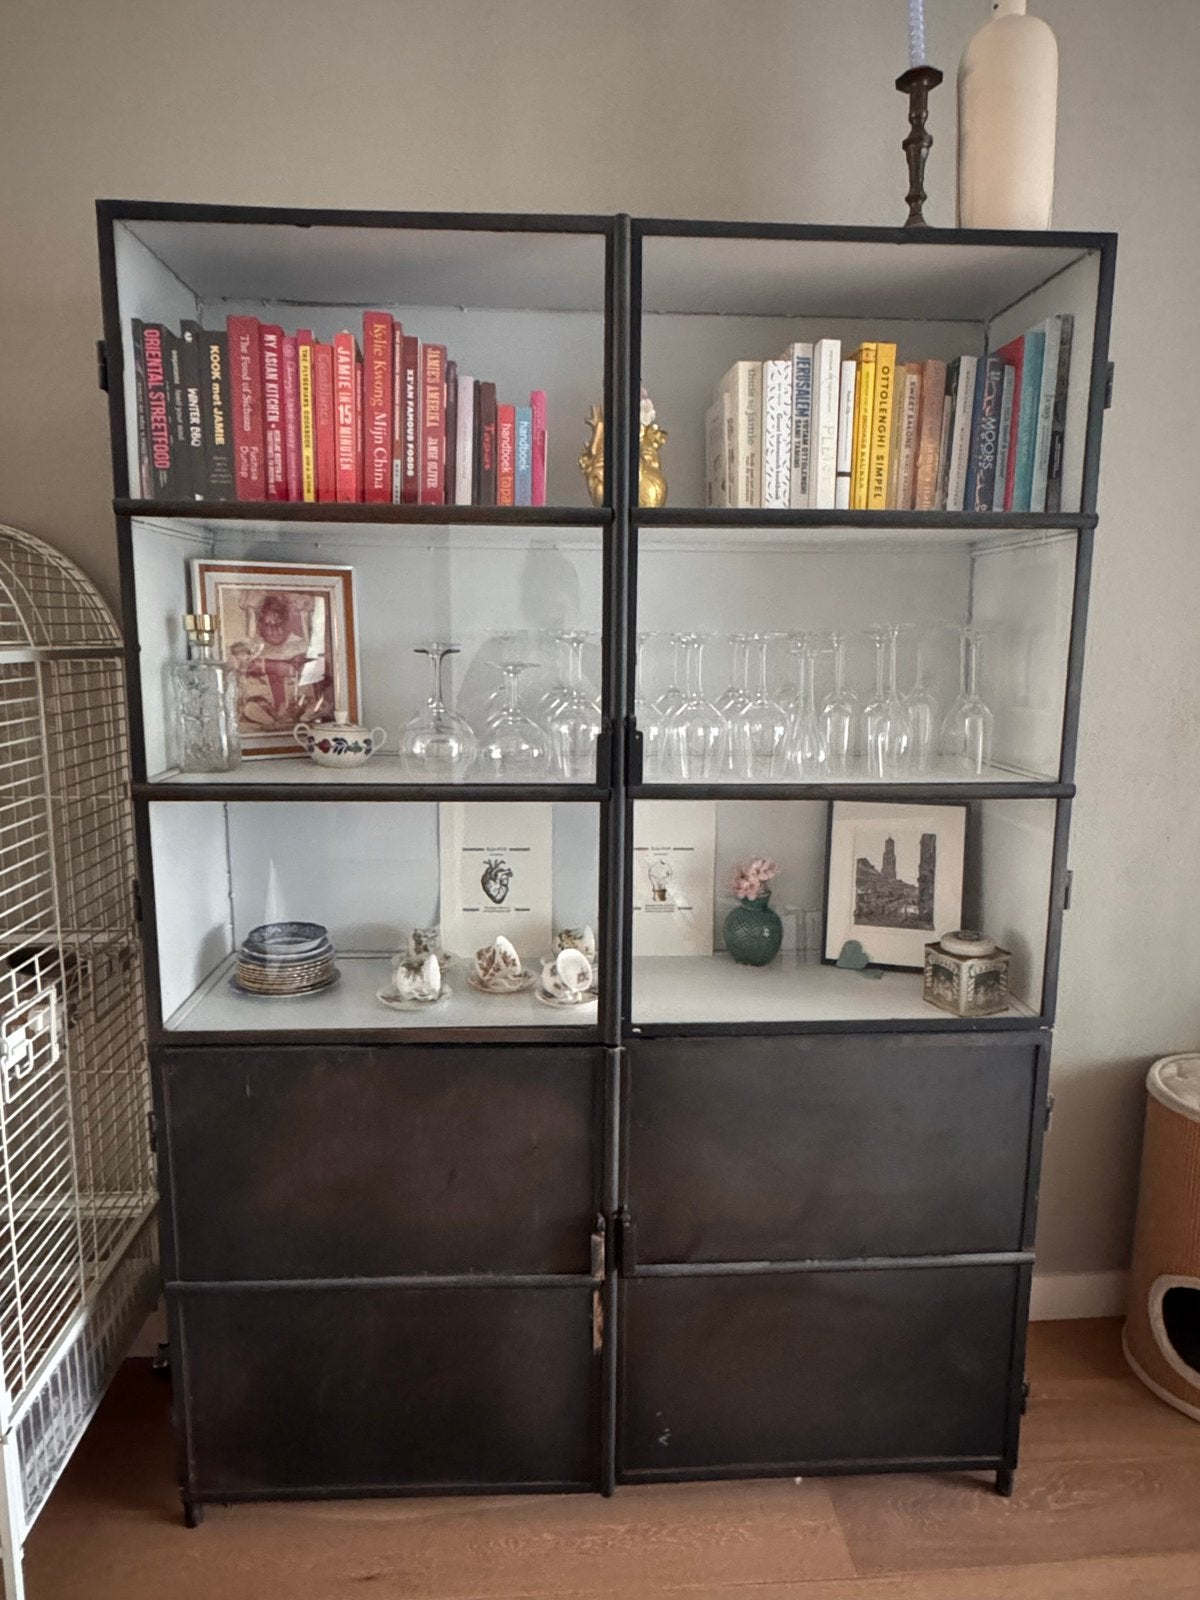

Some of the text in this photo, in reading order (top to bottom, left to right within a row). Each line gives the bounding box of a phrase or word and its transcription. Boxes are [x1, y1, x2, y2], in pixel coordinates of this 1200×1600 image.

[143, 329, 164, 389] ORIENTAL
[210, 345, 221, 379] KOOK
[240, 335, 250, 353] The
[263, 335, 277, 348] MY
[241, 357, 252, 380] Food
[242, 382, 253, 392] of
[265, 351, 278, 380] ASIAN
[794, 356, 811, 417] JERUSALEM
[187, 388, 201, 446] WINTER BBQ
[212, 383, 223, 405] met
[265, 383, 279, 422] KITCHEN
[337, 347, 352, 470] JAMIE IN 15 MINUTEN
[369, 324, 388, 488] Kylie Kwong Mijn China
[427, 386, 440, 427] AMERIKA
[904, 381, 916, 449] SWEET SALONE
[149, 392, 169, 468] STREETFOOD
[213, 408, 225, 445] JAMIE
[303, 410, 311, 448] COOKBOOK
[406, 369, 414, 476] XI'AN FAMOUS FOODS
[519, 421, 529, 470] handboek
[745, 412, 757, 445] jamie
[873, 366, 890, 499] OTTOLENGHI SIMPEL
[982, 417, 997, 470] MOORS
[427, 436, 438, 488] JAMIE OLIVER
[501, 423, 512, 473] handboek
[800, 448, 808, 494] OTTOLENGHI
